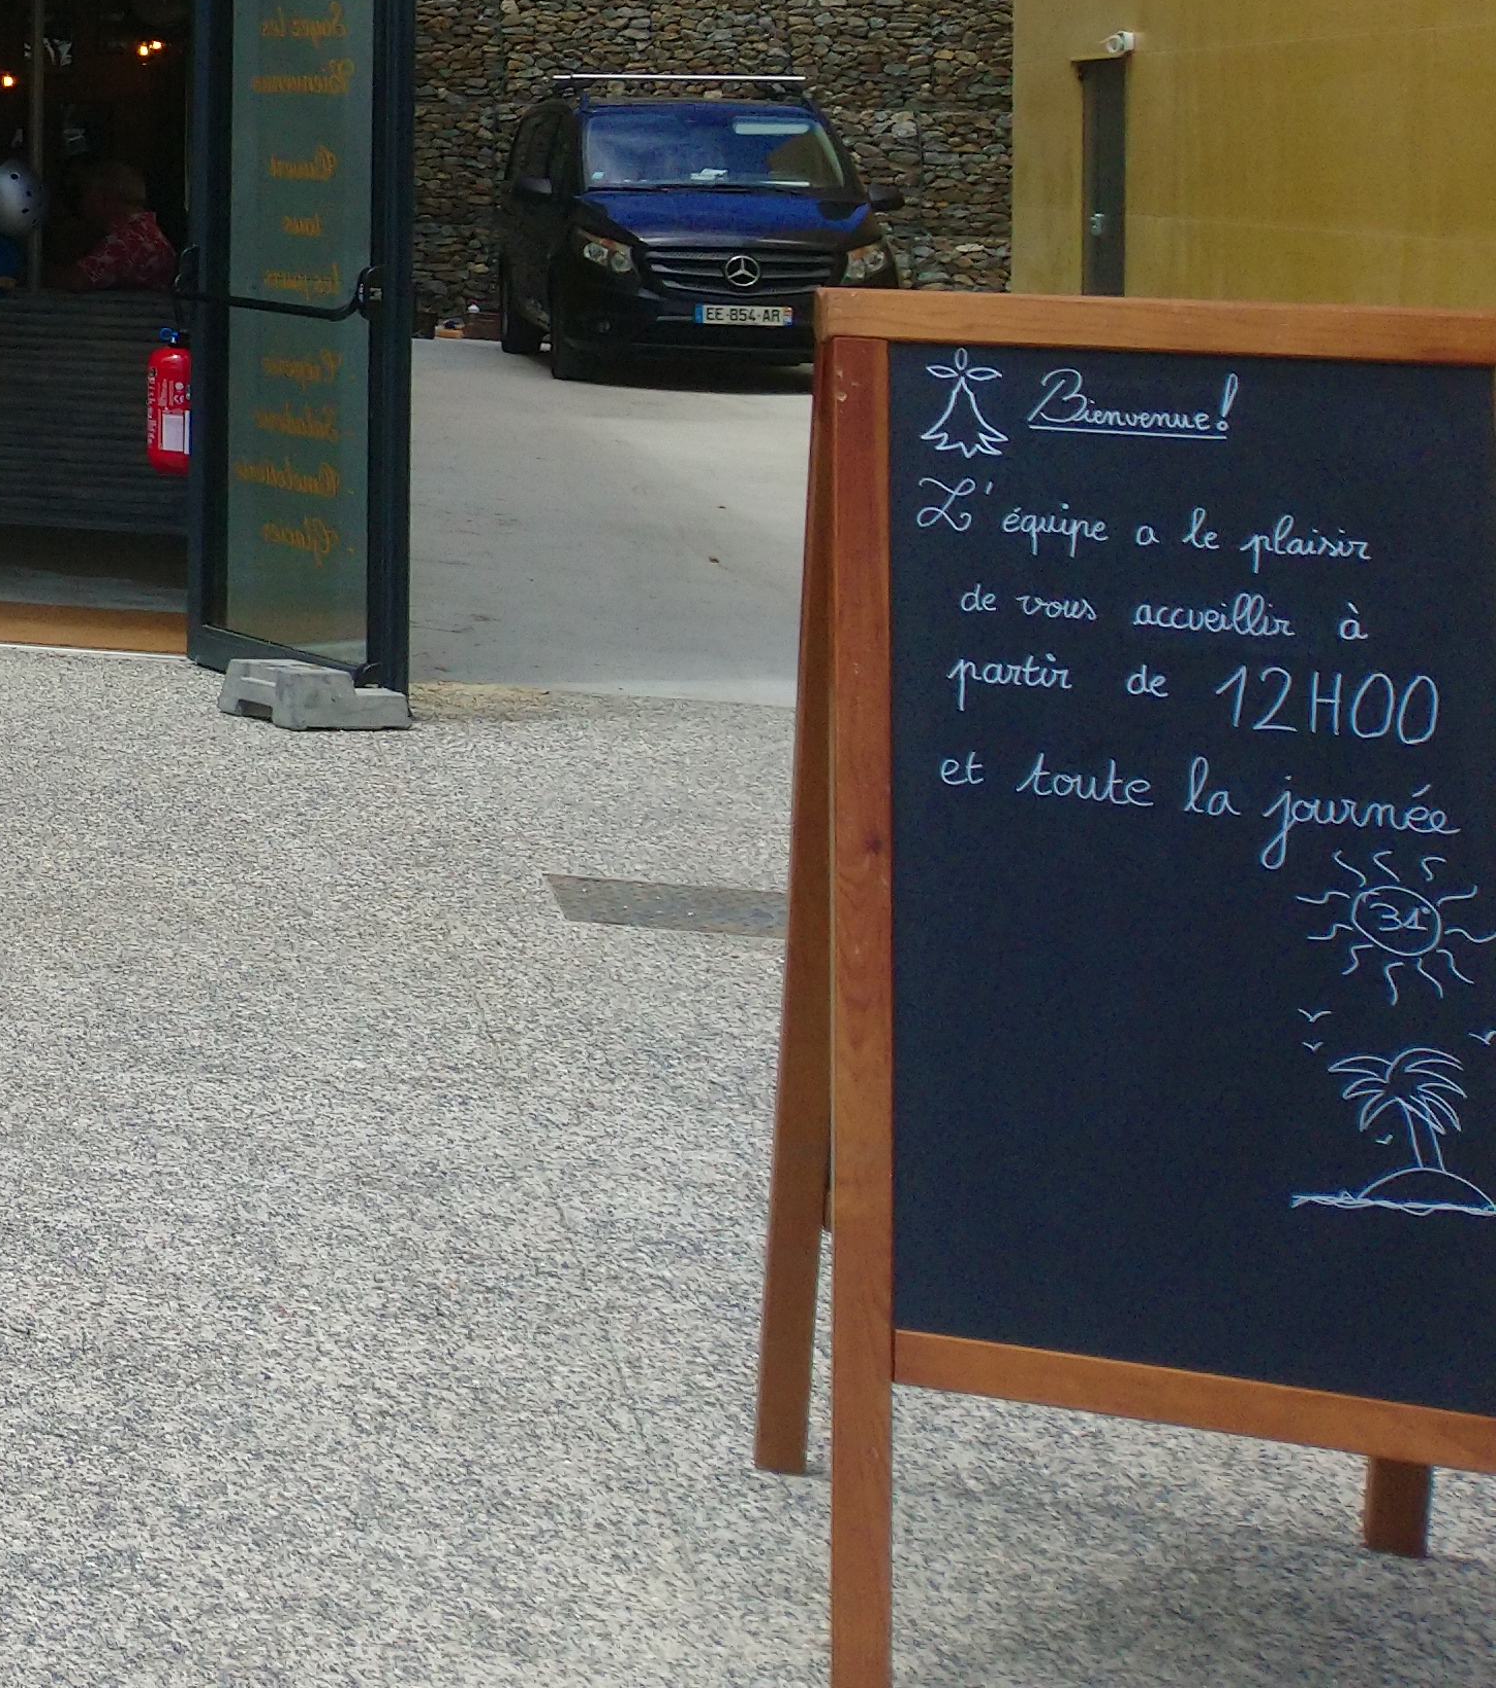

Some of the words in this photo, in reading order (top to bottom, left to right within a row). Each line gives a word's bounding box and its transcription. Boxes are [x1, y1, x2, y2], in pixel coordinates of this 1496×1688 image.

[706, 307, 781, 323] EE-854-AR
[1136, 524, 1160, 546] a
[1183, 507, 1220, 550] le
[1240, 514, 1372, 574] plaisir
[960, 583, 997, 613] de
[1015, 595, 1098, 621] vous
[1133, 593, 1296, 637] accueillir
[1340, 603, 1368, 640] à
[947, 653, 1073, 712] partir
[1127, 664, 1169, 697] de
[1215, 665, 1440, 745] 12H00
[940, 752, 985, 786] et
[1016, 753, 1155, 806] toute
[1185, 756, 1241, 816] la
[1260, 774, 1461, 870] journée
